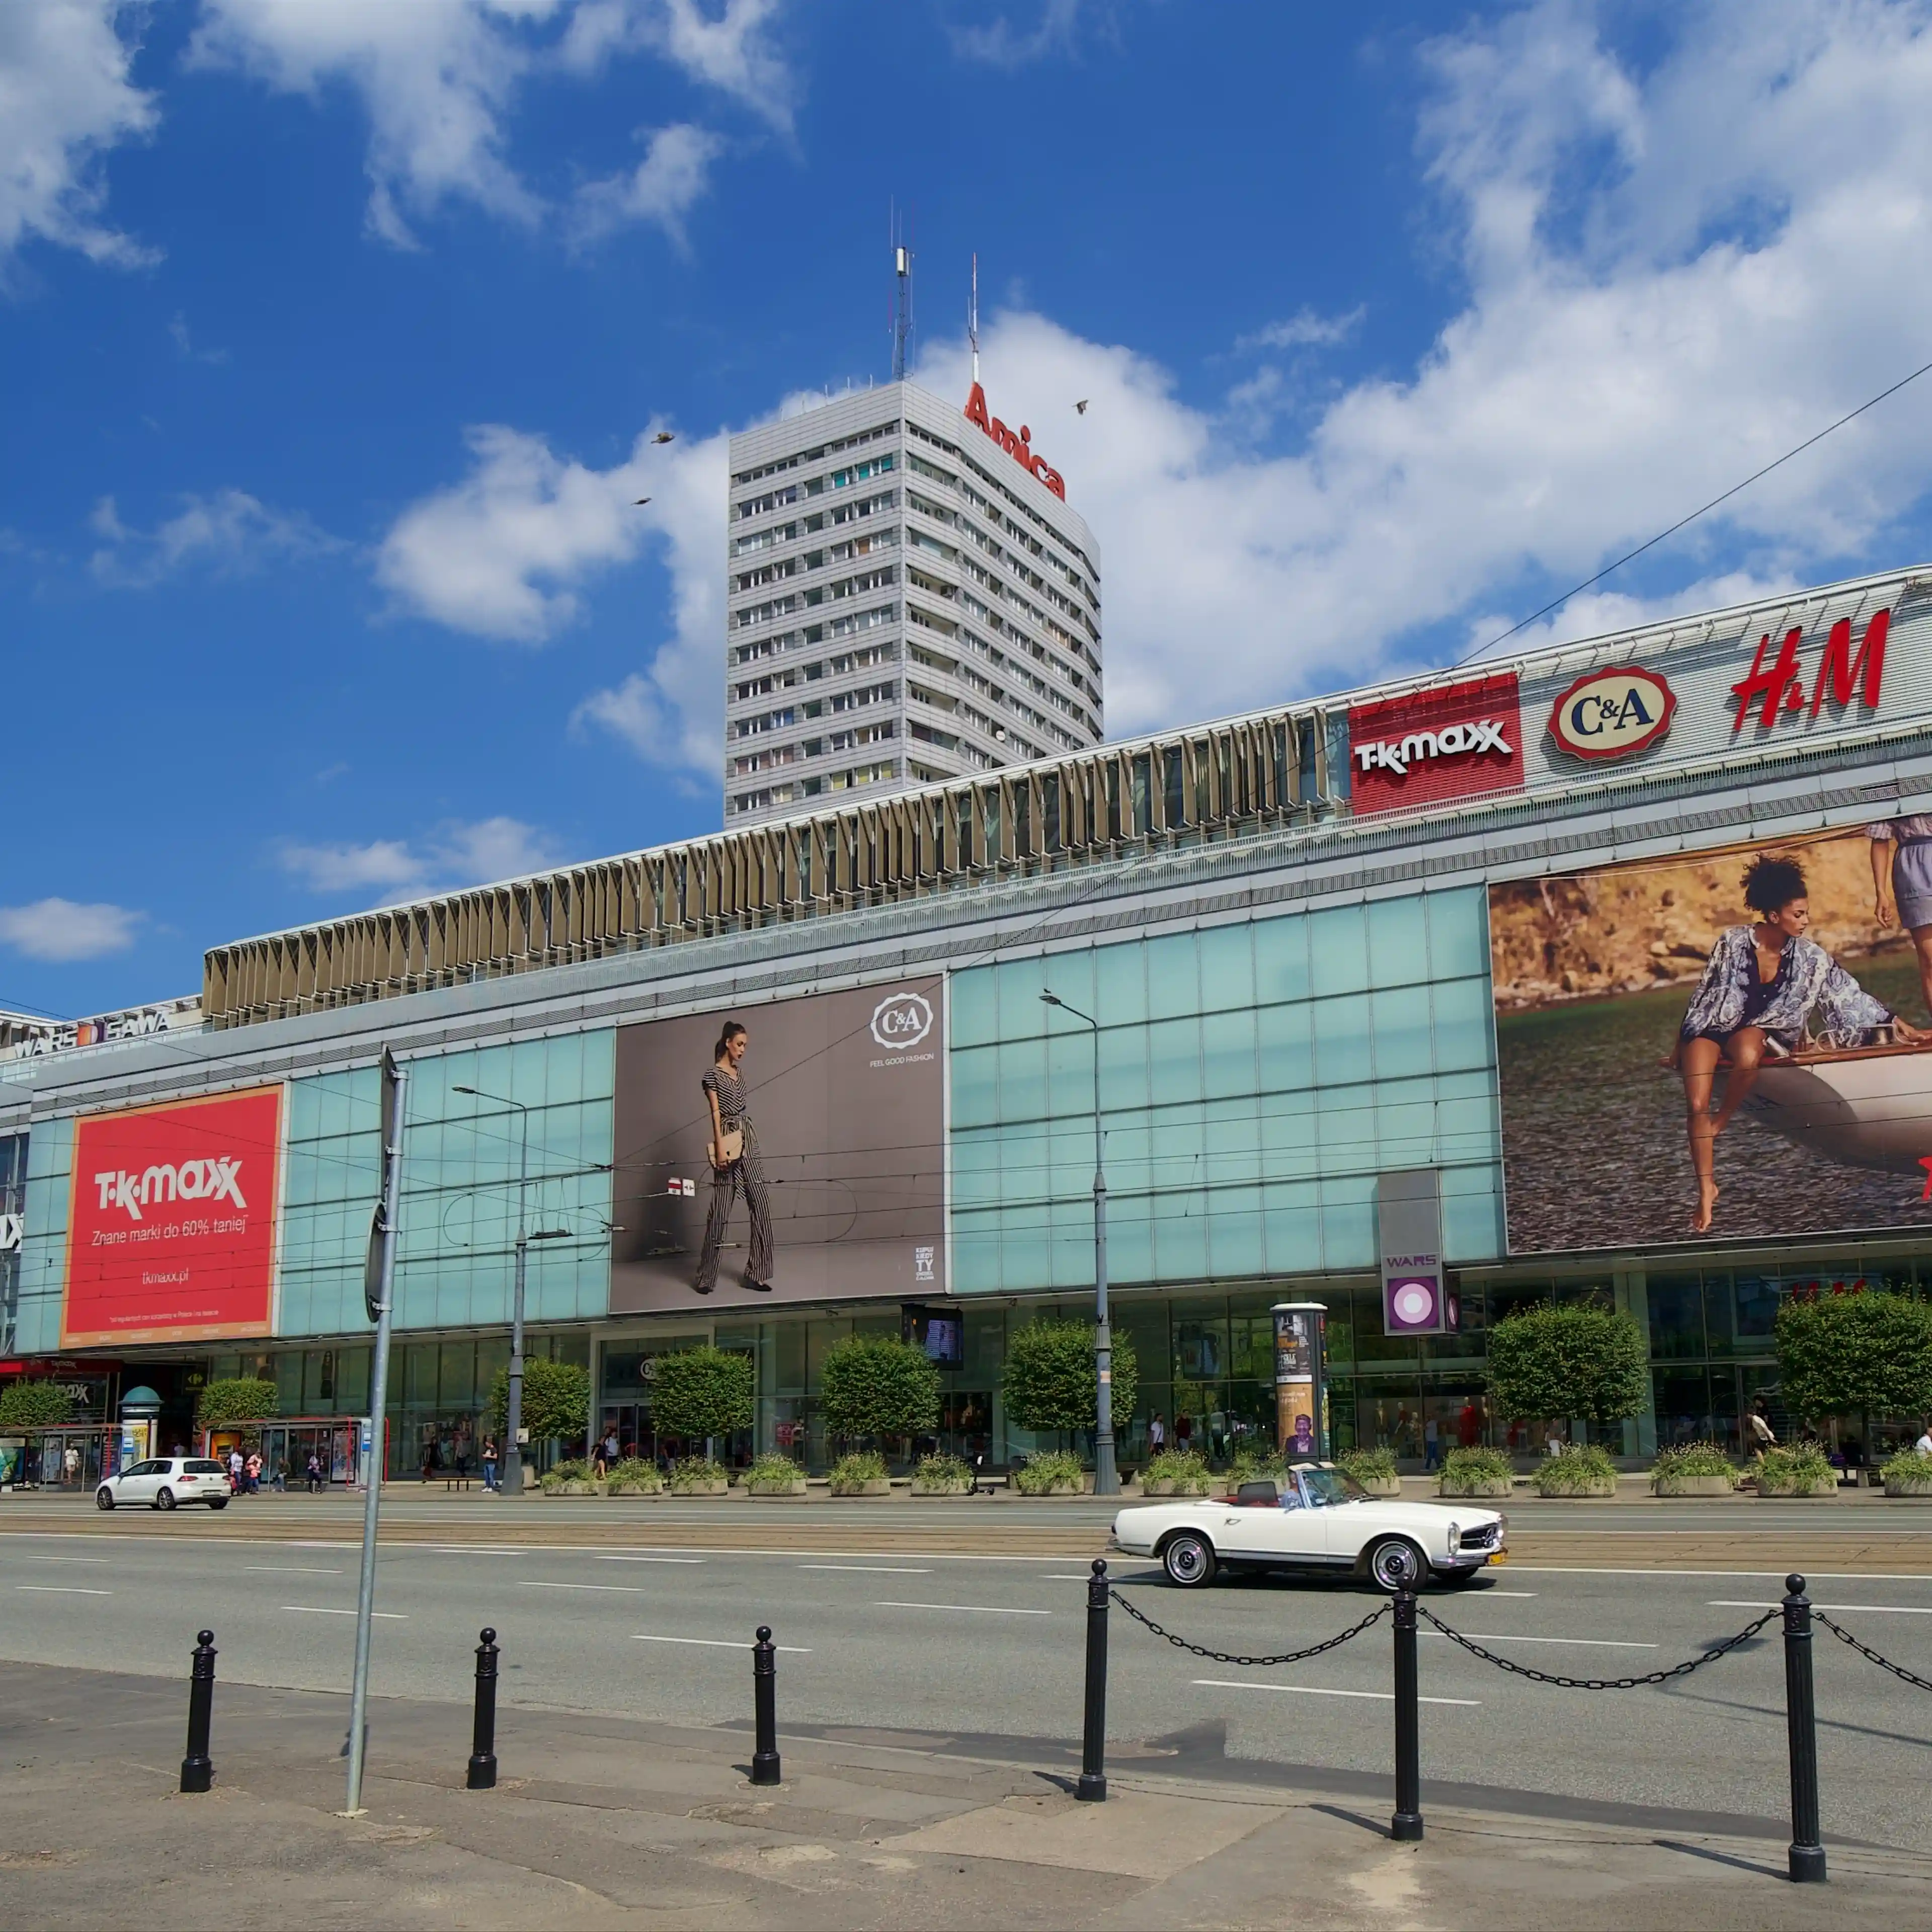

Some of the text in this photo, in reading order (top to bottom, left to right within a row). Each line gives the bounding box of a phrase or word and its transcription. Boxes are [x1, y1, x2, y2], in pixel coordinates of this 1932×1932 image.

[963, 382, 1066, 503] Amica
[1731, 607, 1891, 733] H&M
[1571, 688, 1655, 736] C&A
[882, 1007, 922, 1034] C&A
[15, 1030, 78, 1059] WARS
[870, 1053, 934, 1068] FEEL GOOD FASHION
[91, 1231, 126, 1246] Znane
[129, 1224, 160, 1242] marki
[164, 1223, 179, 1239] do
[183, 1219, 209, 1236] 60%
[915, 1259, 934, 1272] TY
[1387, 1255, 1437, 1268] WARS
